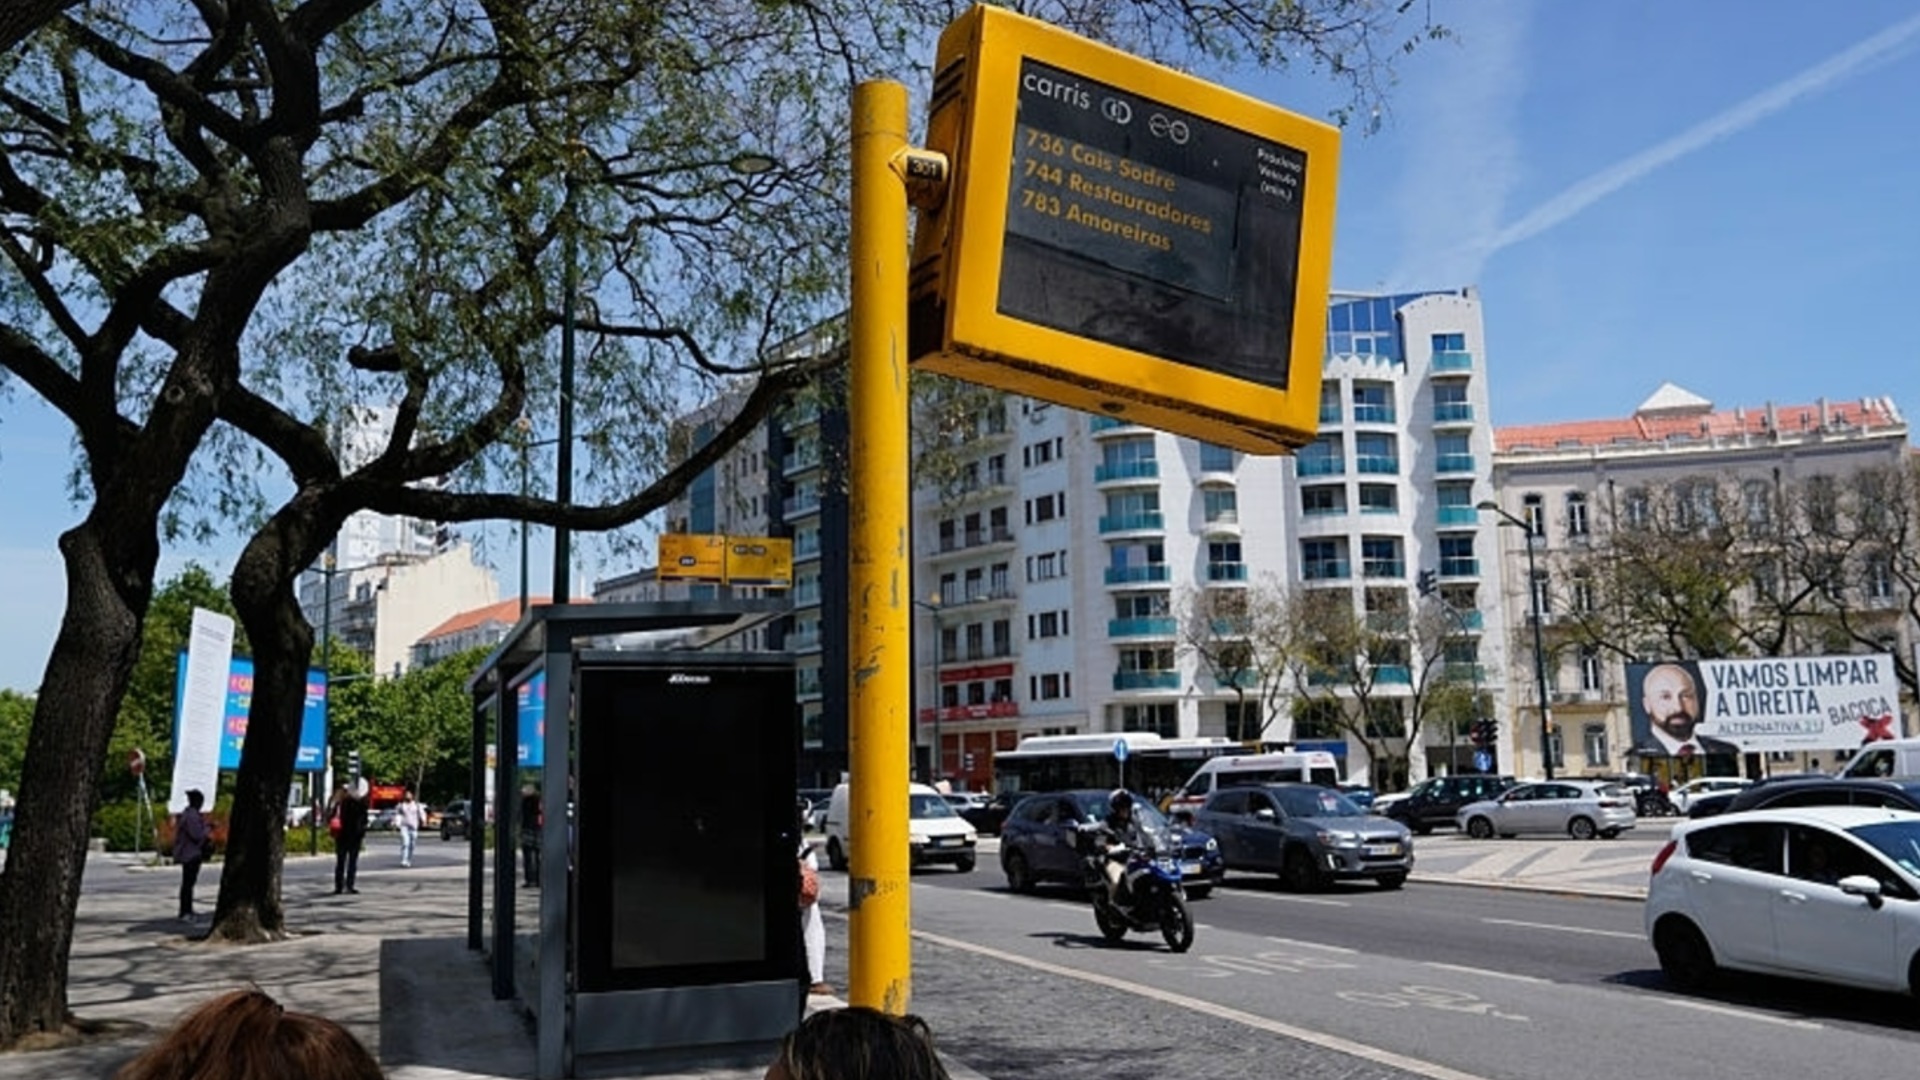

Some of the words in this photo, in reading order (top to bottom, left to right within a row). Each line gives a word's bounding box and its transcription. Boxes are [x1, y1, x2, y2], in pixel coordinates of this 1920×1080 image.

[1023, 73, 1091, 110] carris
[1026, 129, 1064, 157] 736
[1071, 143, 1113, 172] Cais
[1024, 159, 1062, 186] 744
[1069, 173, 1213, 233] Restauradores
[1022, 190, 1061, 216] 783
[1066, 204, 1172, 250] Amoreiras
[1710, 662, 1790, 689] VAMOS
[1795, 659, 1879, 687] LIMPAR
[1716, 692, 1731, 717] A
[1736, 690, 1821, 716] DIREITA
[1717, 721, 1801, 735] ALTERNATIVA
